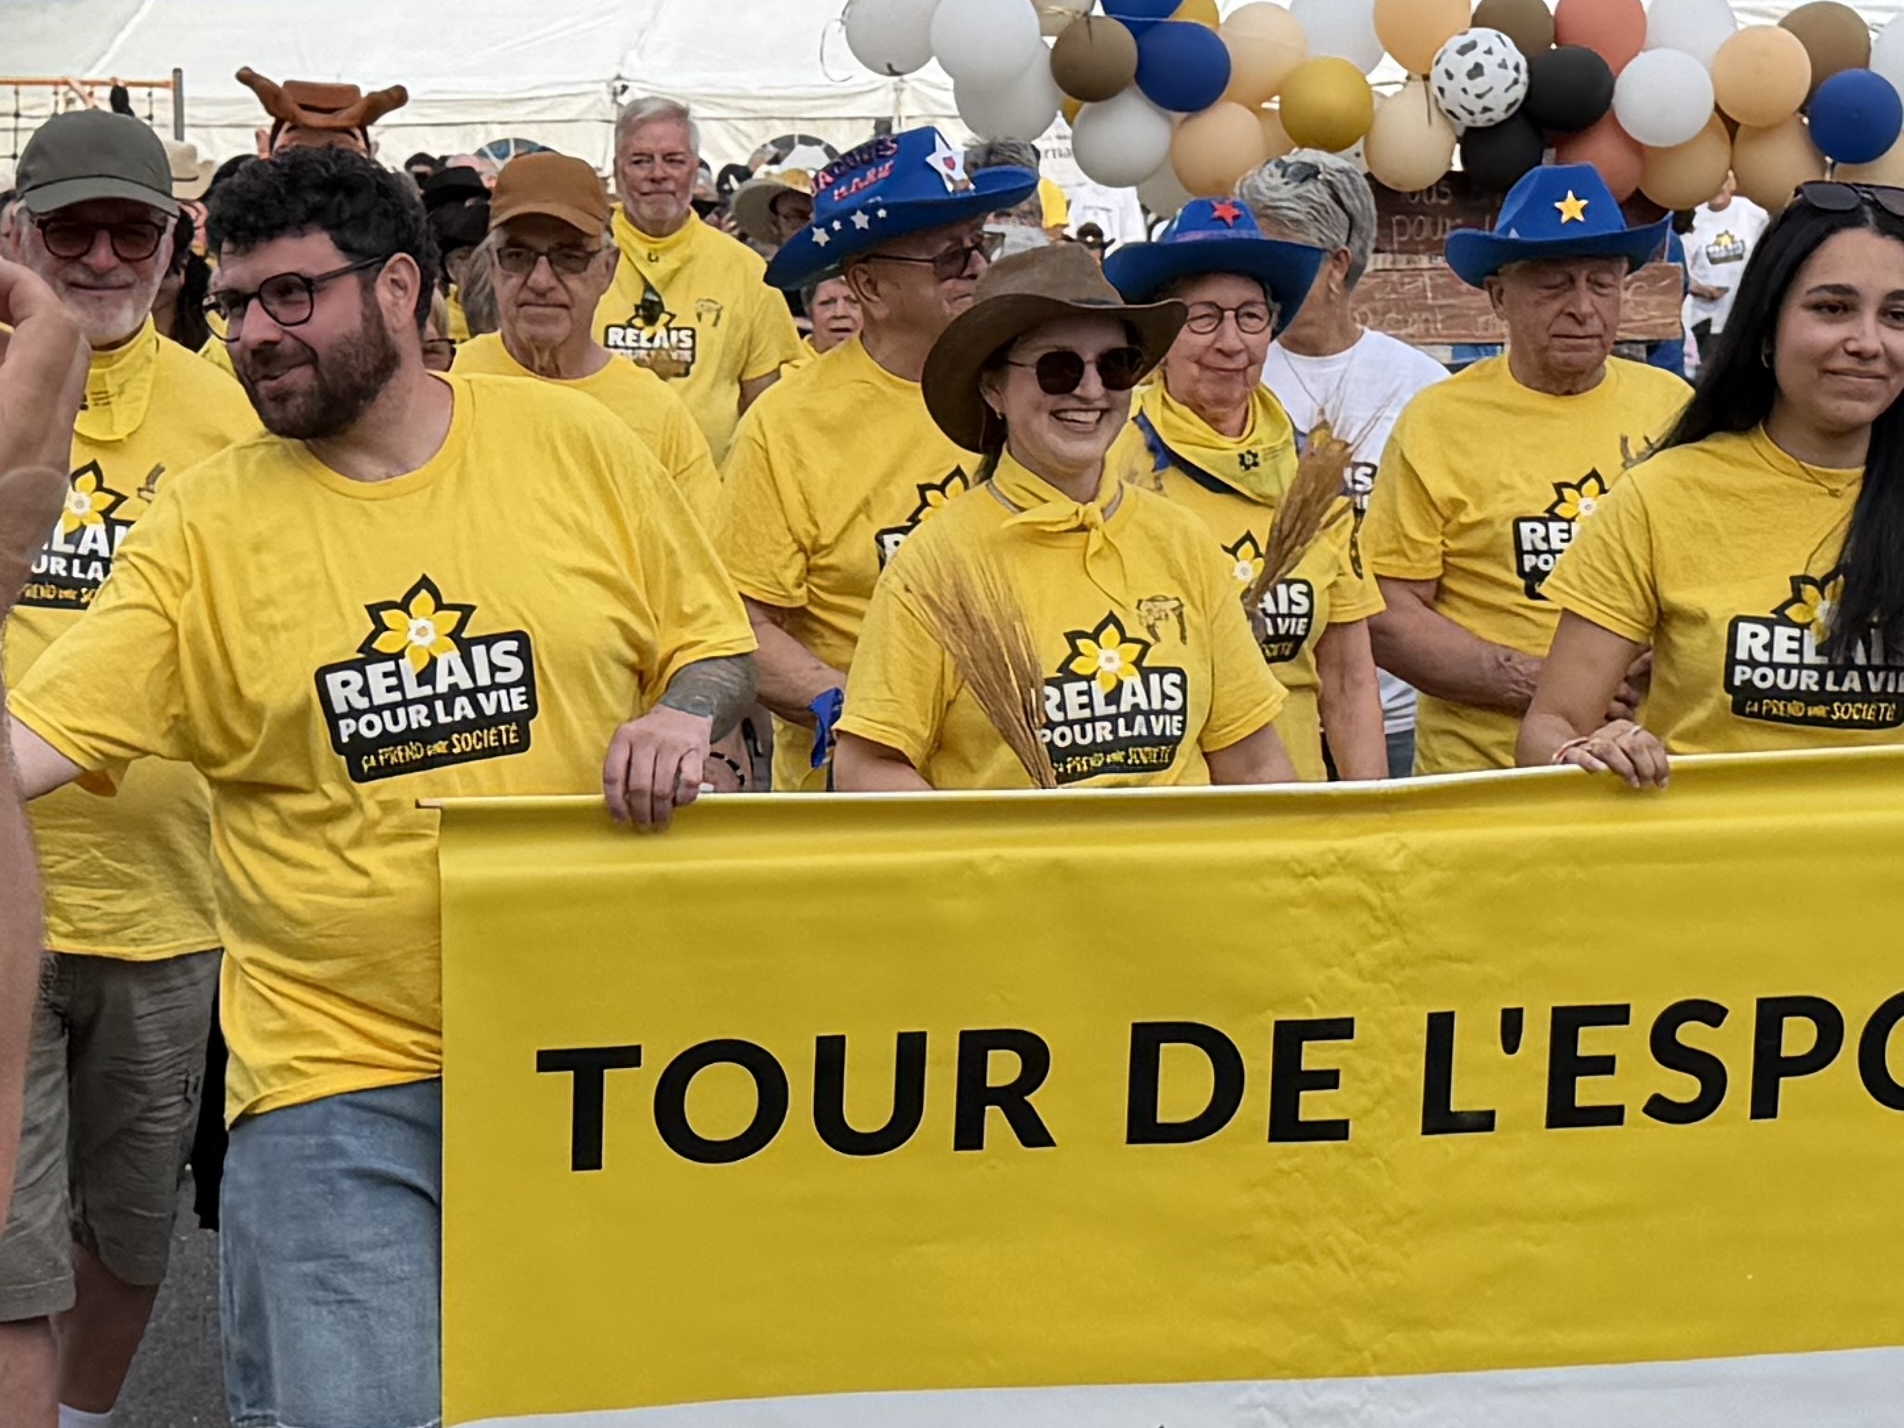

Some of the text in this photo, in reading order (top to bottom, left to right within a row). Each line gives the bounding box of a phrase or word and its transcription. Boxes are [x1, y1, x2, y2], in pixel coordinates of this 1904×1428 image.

[1276, 617, 1309, 636] VIE
[325, 639, 525, 714] RELAIS
[1043, 672, 1184, 722] RELAIS
[1733, 665, 1820, 691] POUR
[1825, 670, 1862, 693] LA
[337, 685, 530, 744] POUR LA VIE
[1036, 714, 1184, 748] POUR LA VIE
[451, 722, 520, 754] SOCIÉTÉ
[536, 1027, 1056, 1172] TOUR
[1125, 1017, 1354, 1145] DE
